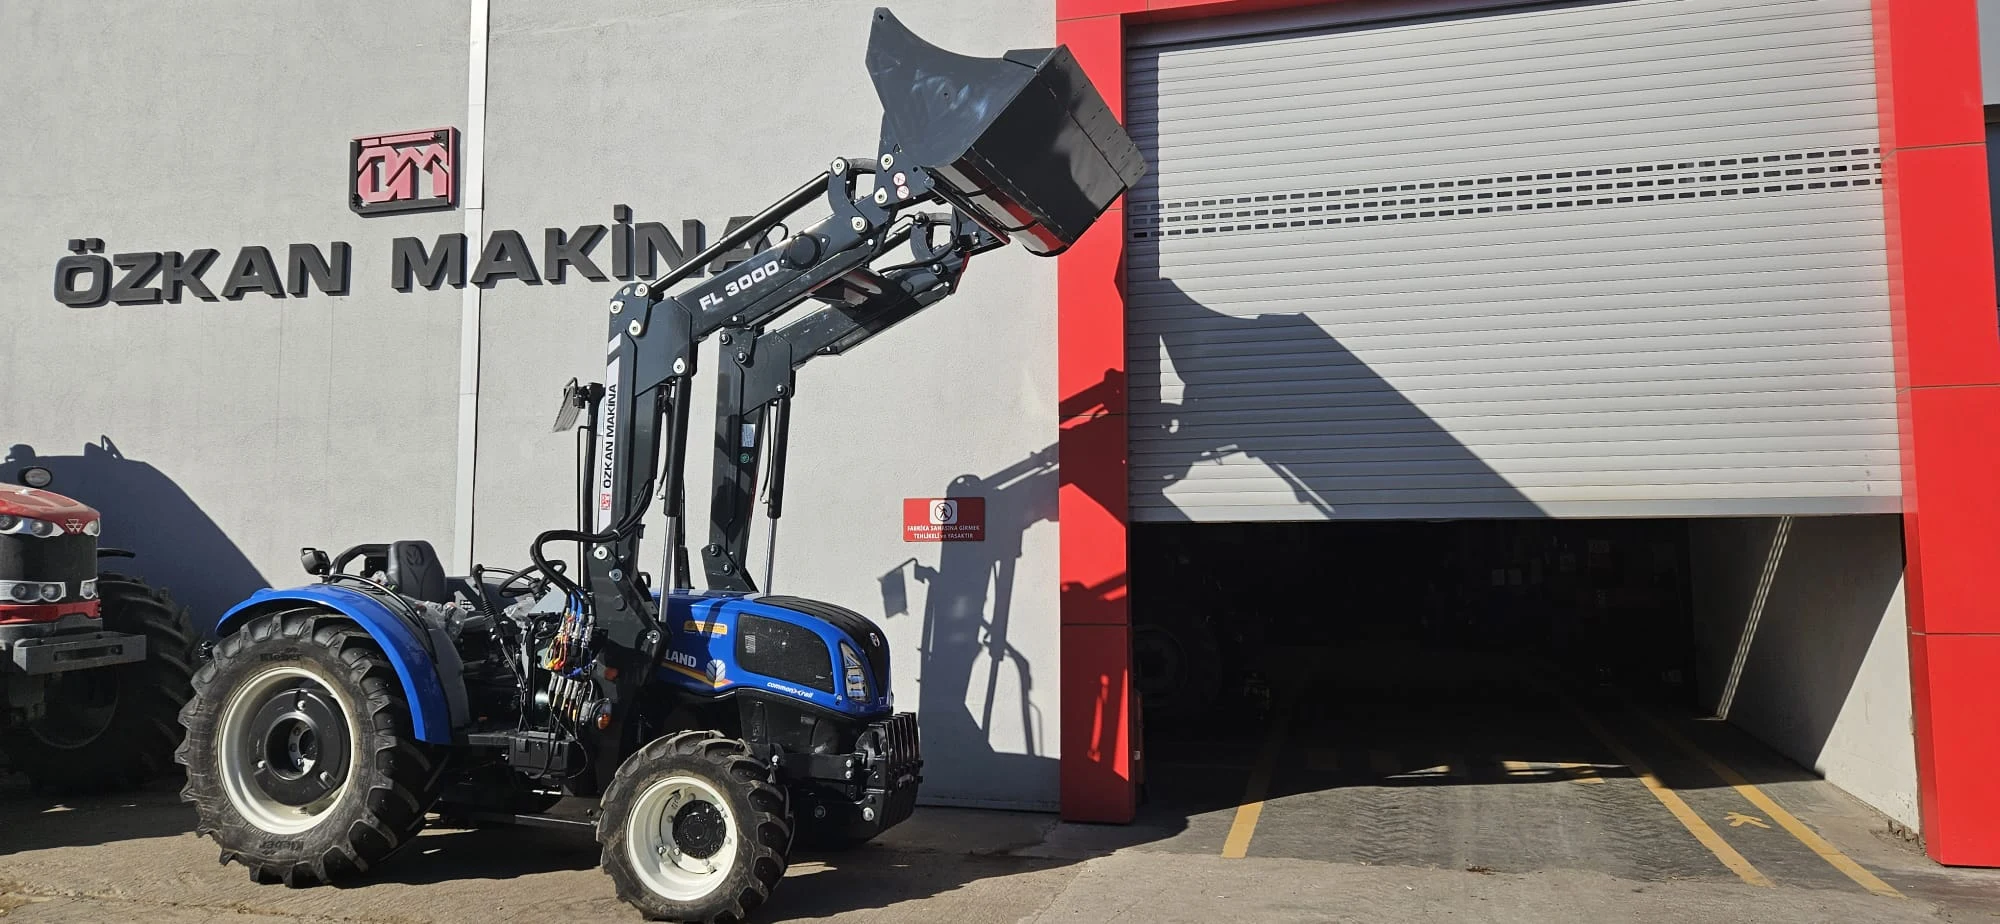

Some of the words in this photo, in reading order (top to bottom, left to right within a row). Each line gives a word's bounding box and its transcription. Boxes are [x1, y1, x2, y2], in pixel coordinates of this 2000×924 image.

[54, 237, 352, 308] ÖZKAN
[391, 204, 773, 293] MAKİNA
[699, 293, 724, 312] FL
[725, 260, 780, 297] 3000
[606, 384, 617, 438] MAKİNA
[664, 649, 697, 668] LAND
